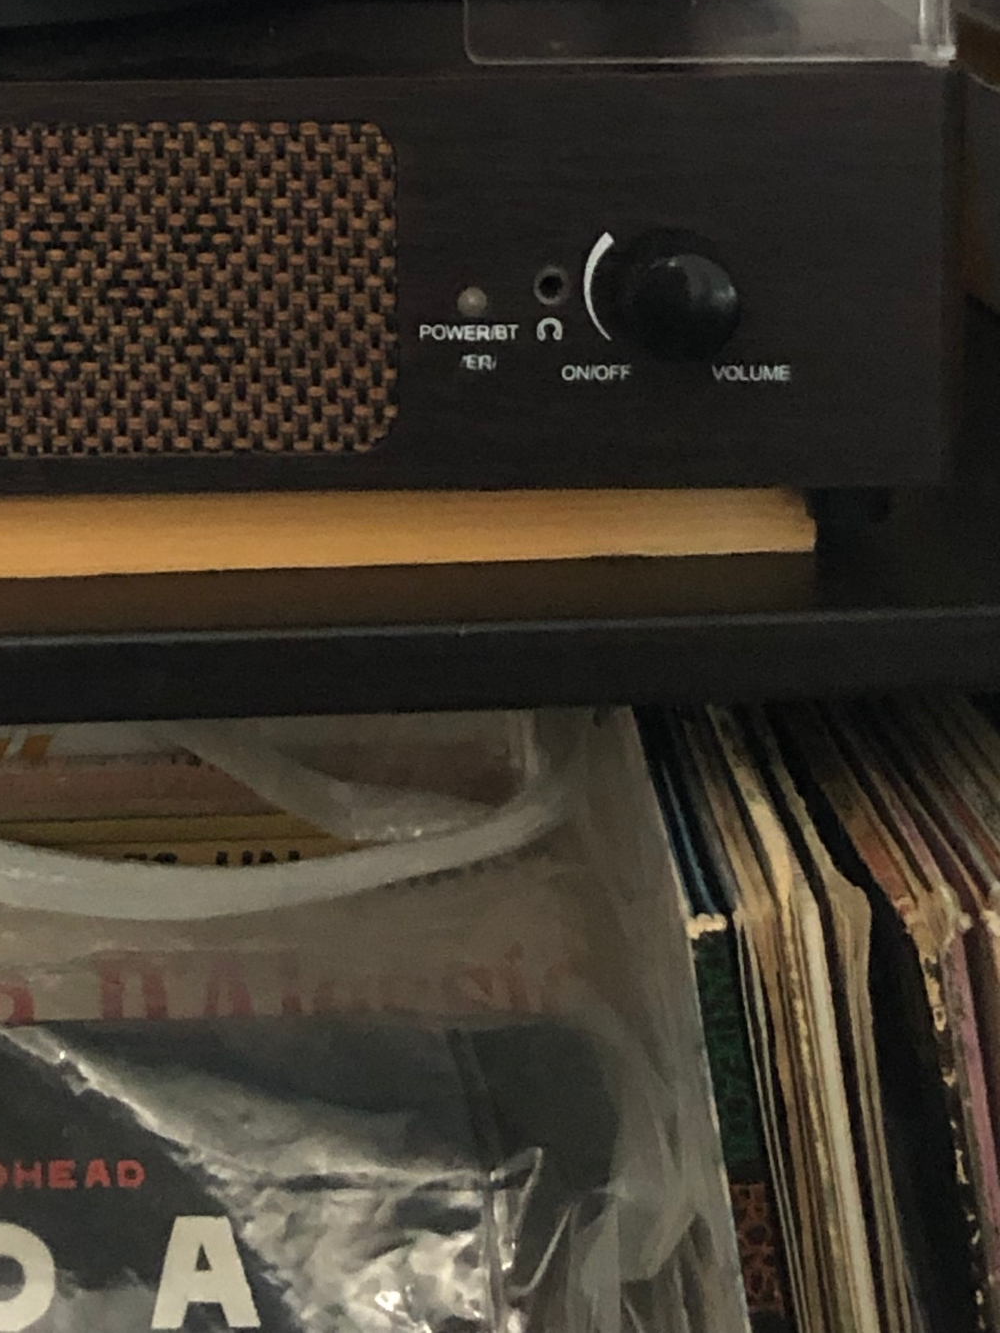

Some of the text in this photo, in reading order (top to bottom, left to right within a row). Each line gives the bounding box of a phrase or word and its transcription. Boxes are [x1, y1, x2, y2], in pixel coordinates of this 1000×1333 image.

[419, 323, 519, 341] POWER/BT
[561, 364, 631, 381] ON/OFF
[712, 364, 791, 382] VOLUME
[151, 1215, 261, 1329] A
